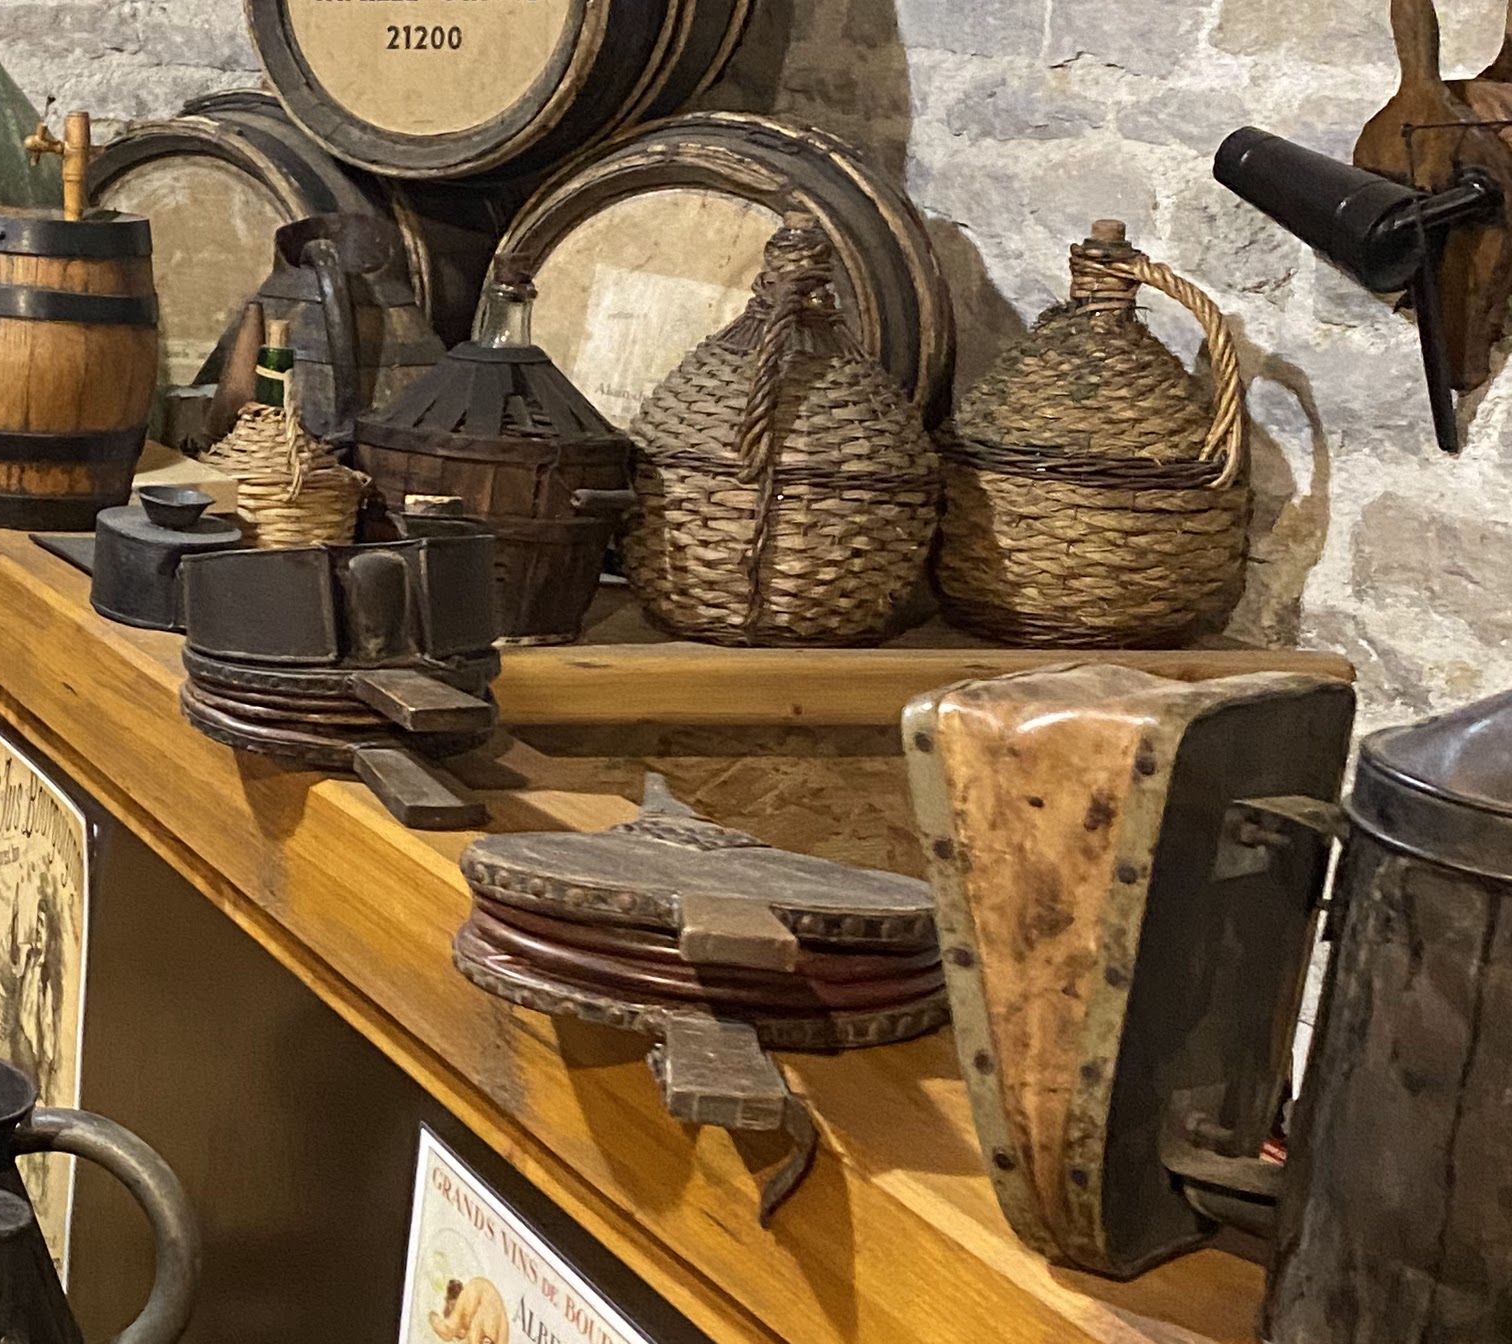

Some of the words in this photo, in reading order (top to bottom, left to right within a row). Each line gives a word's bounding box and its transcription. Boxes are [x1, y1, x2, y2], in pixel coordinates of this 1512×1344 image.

[386, 25, 462, 50] 21200
[432, 1167, 495, 1241] GRANDS
[501, 1230, 538, 1284] VINS
